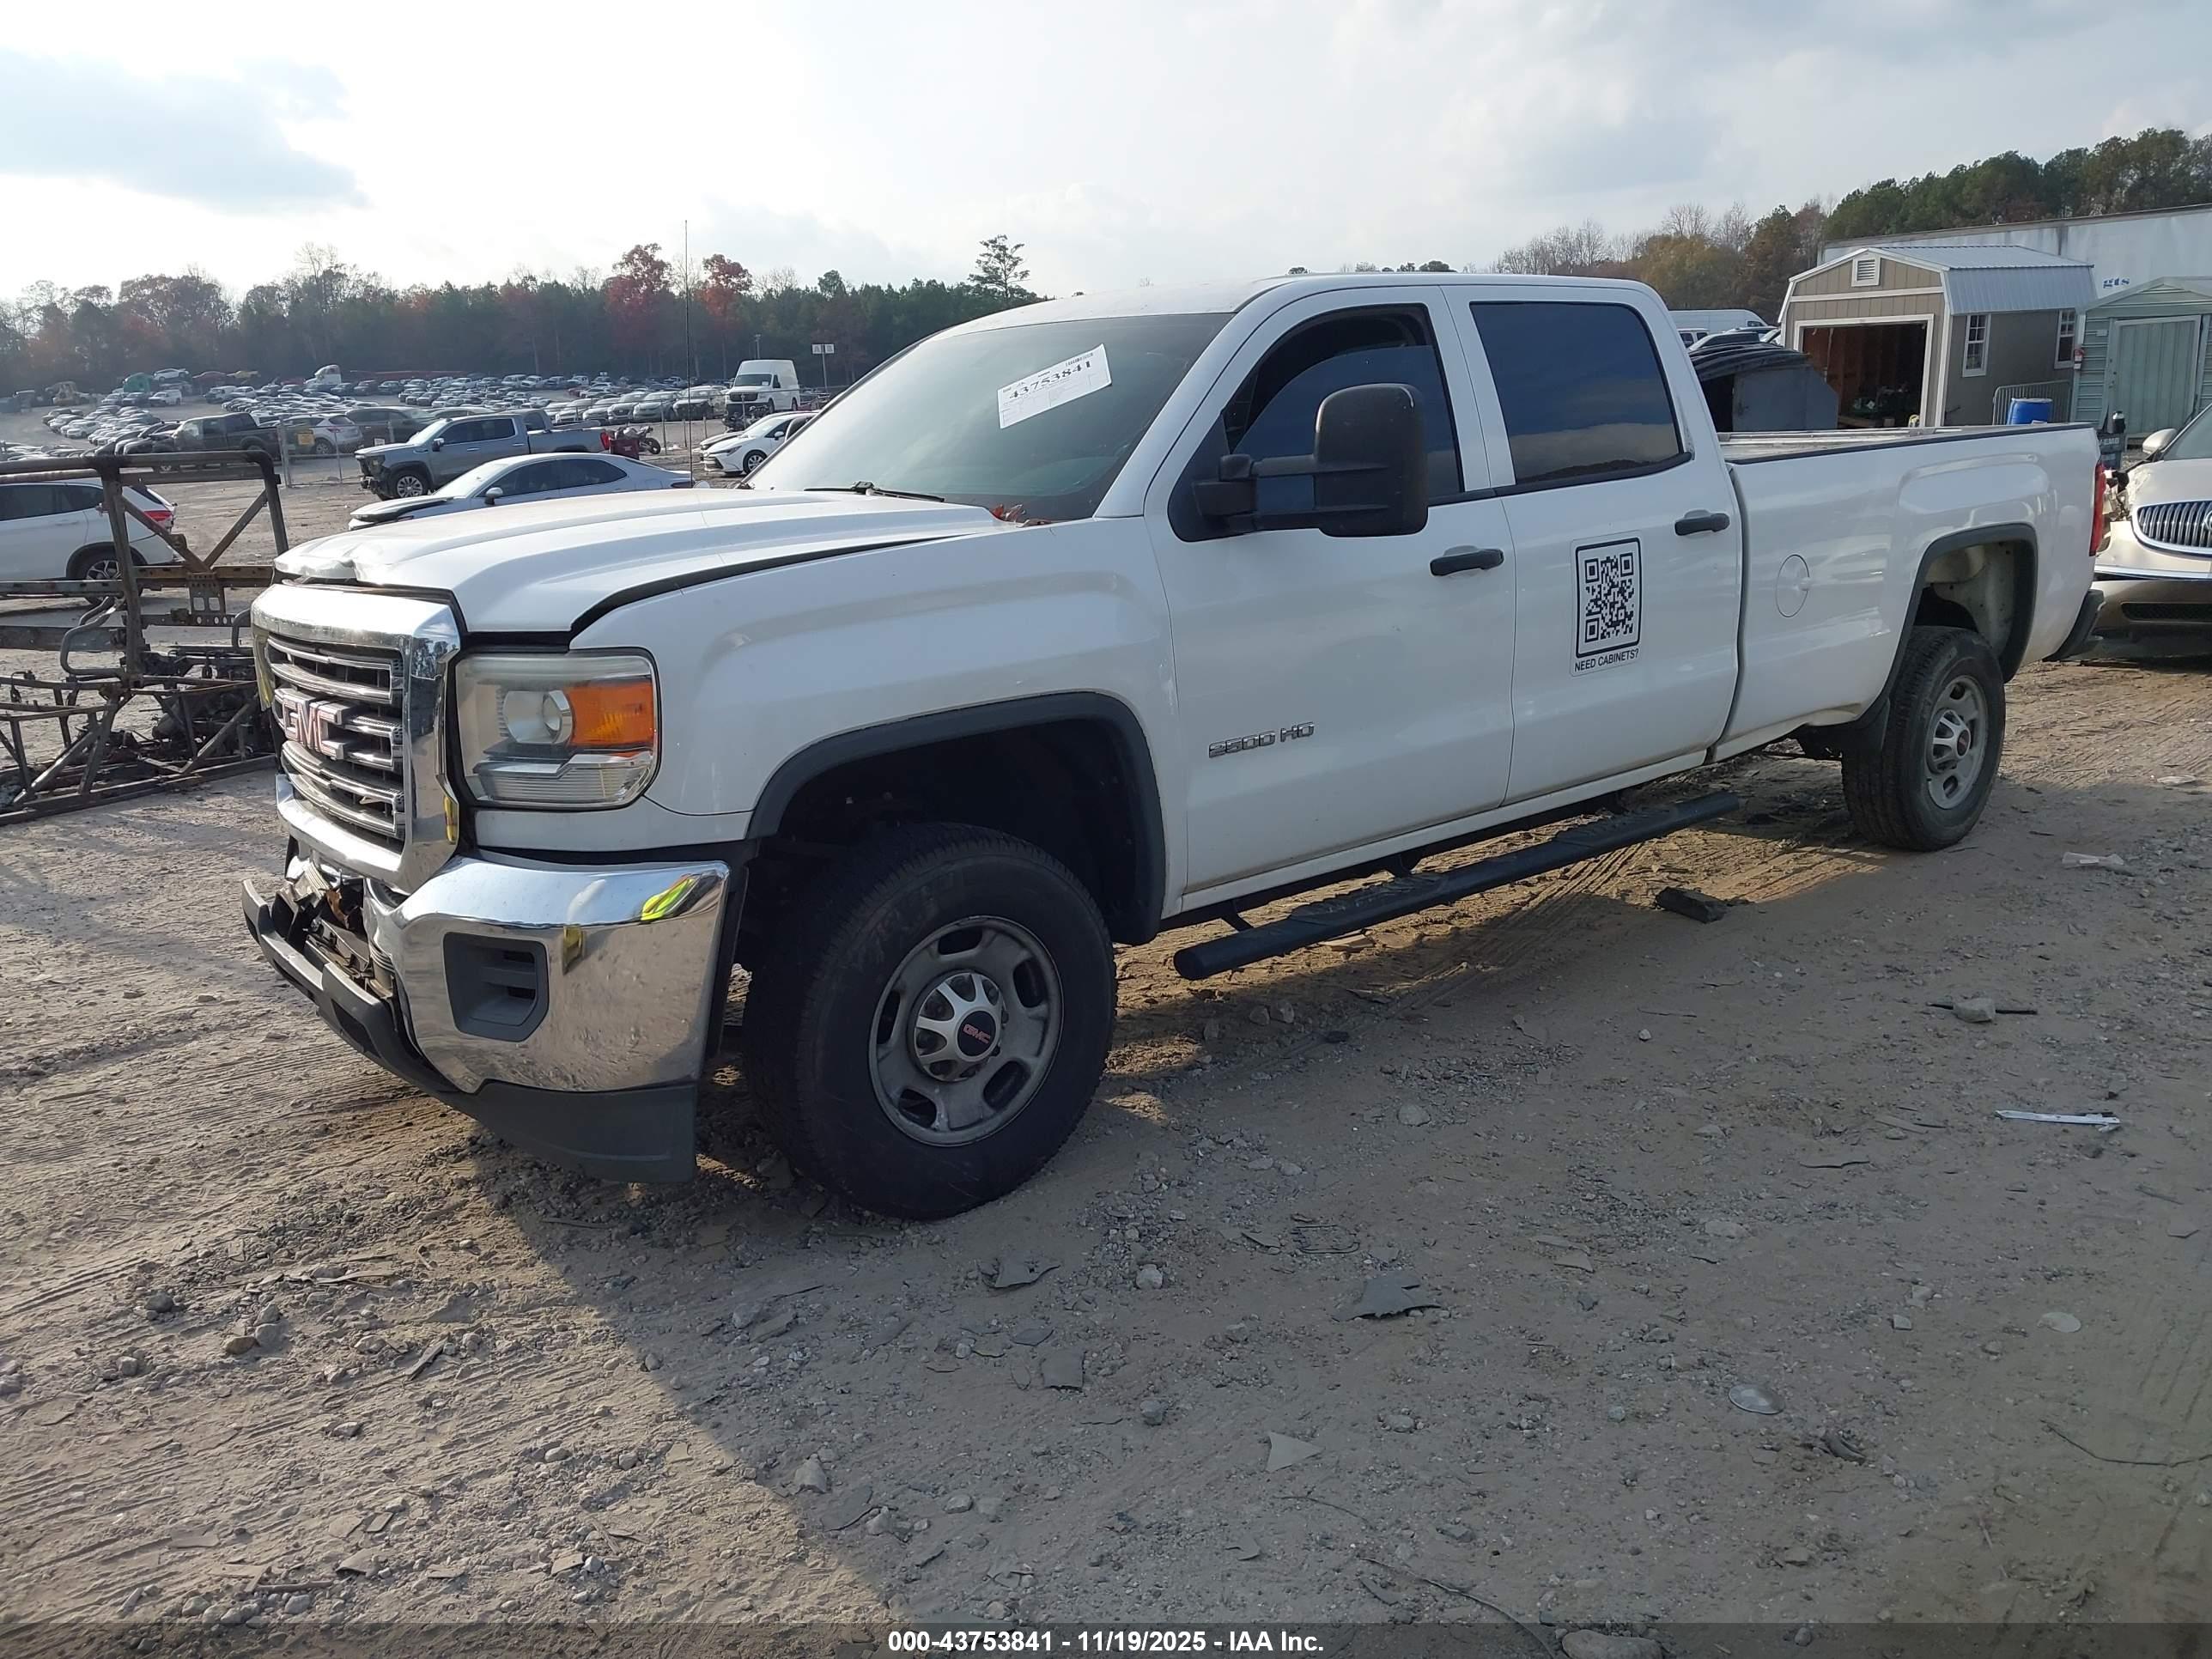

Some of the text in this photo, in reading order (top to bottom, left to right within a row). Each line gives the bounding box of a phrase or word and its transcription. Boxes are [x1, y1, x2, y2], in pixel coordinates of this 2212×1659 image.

[1009, 361, 1091, 400] 43753841
[1574, 648, 1639, 672] NEED CABINETS?
[281, 693, 342, 759] GMC
[1208, 721, 1315, 758] 2500 HD
[963, 1024, 991, 1044] GMC
